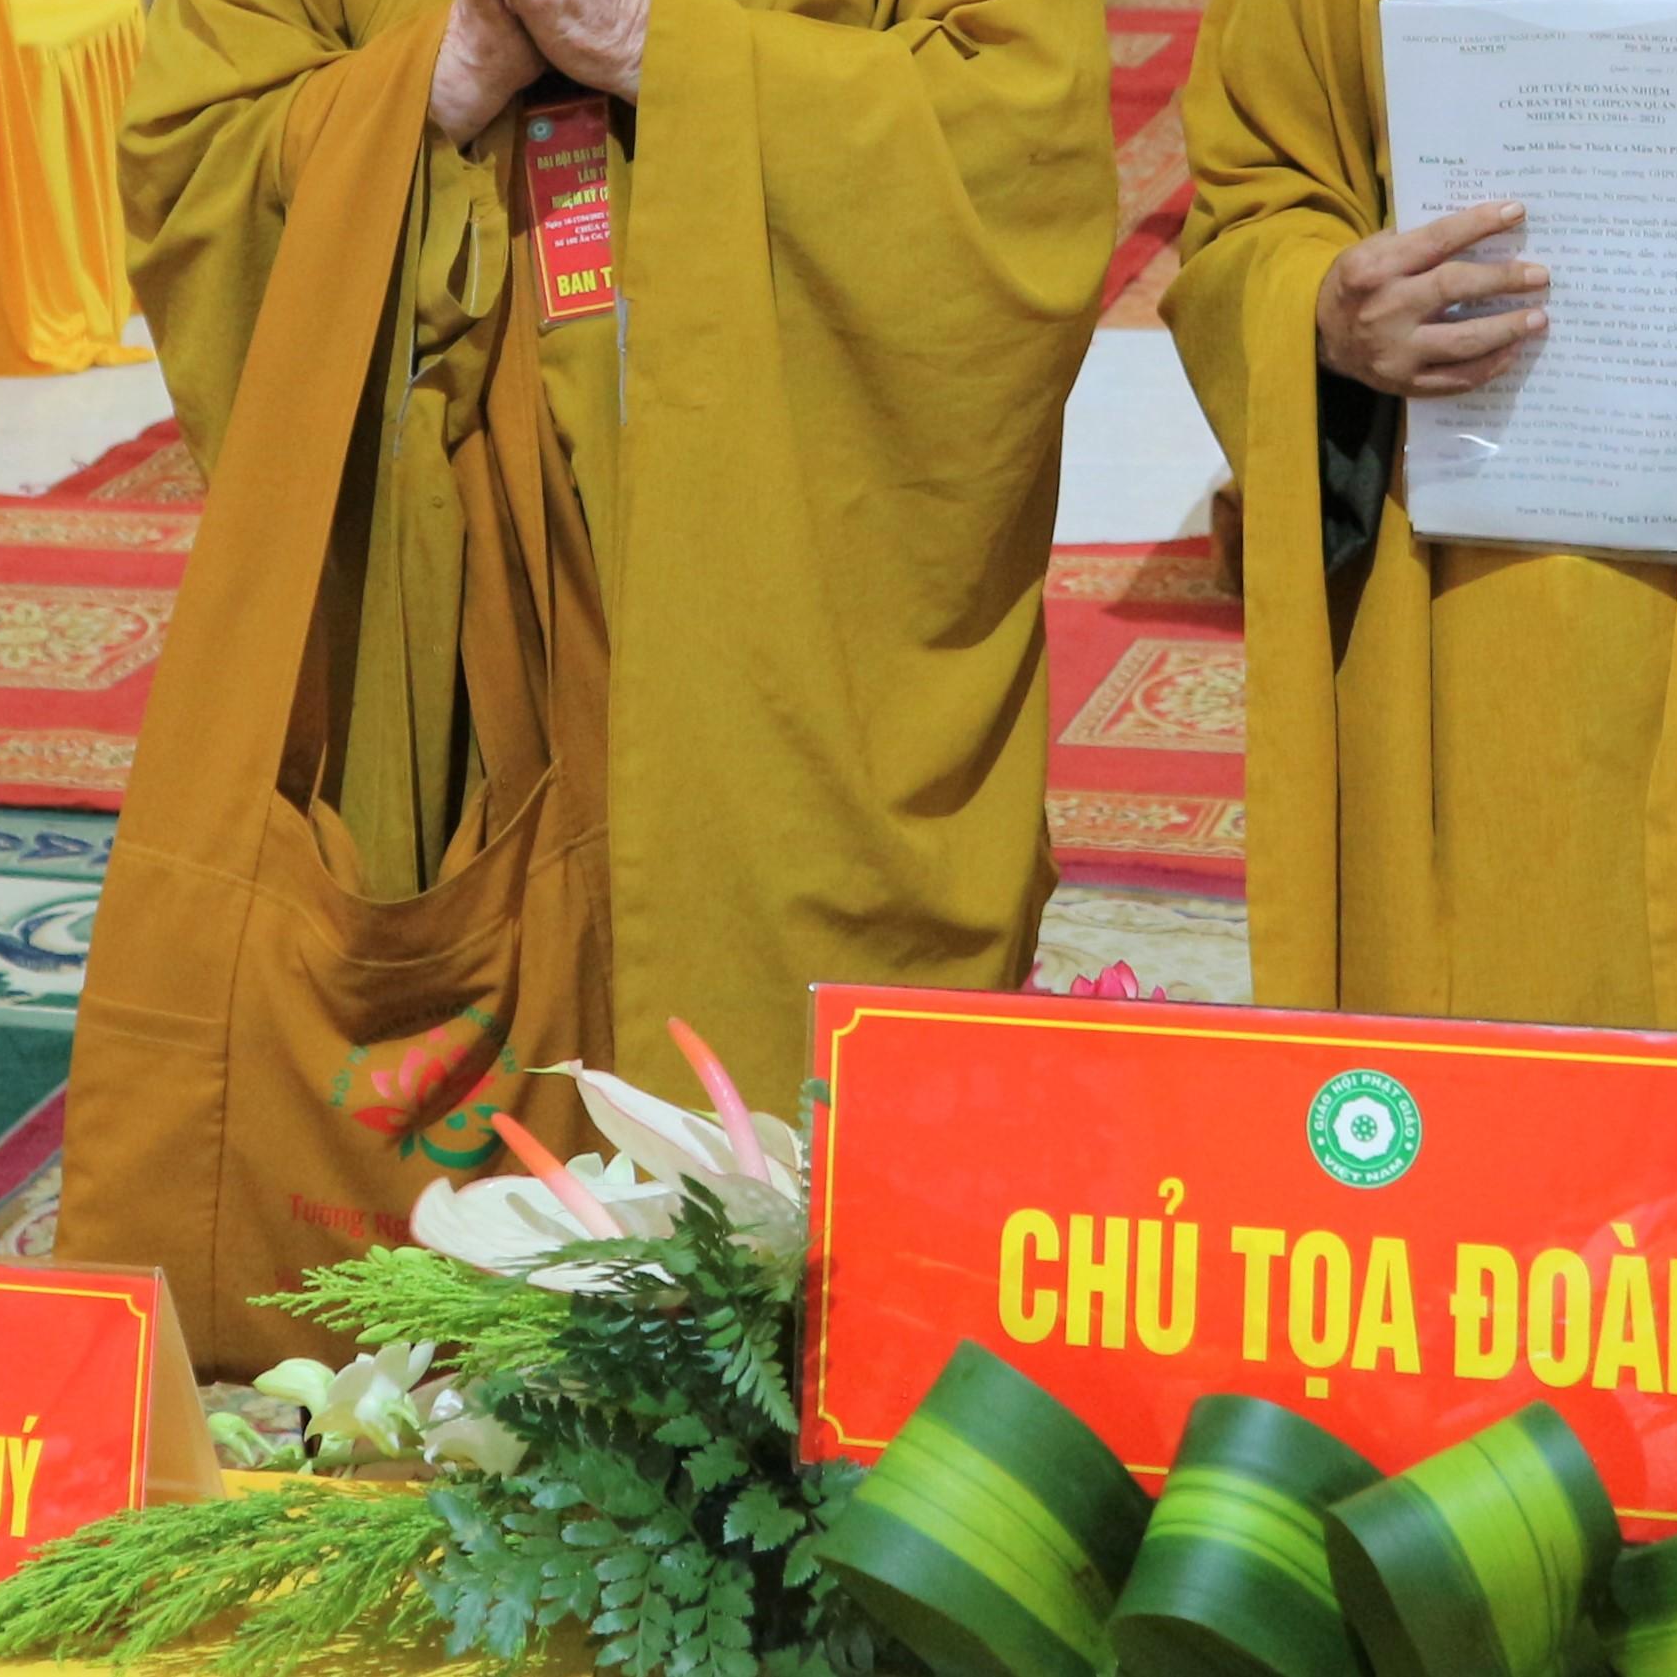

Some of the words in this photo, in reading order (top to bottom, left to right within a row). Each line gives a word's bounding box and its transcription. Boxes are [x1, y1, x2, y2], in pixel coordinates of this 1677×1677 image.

[557, 269, 597, 297] BAN
[600, 266, 613, 289] T
[1314, 1093, 1332, 1131] GIÁO
[1330, 1074, 1358, 1094] HỘI
[1361, 1073, 1402, 1098] PHẬT
[1399, 1100, 1416, 1138] GIÁO
[1324, 1154, 1363, 1181] VIỆT
[1365, 1157, 1404, 1182] NAM
[998, 1177, 1198, 1355] CHỦ
[1230, 1226, 1421, 1398] TỌA
